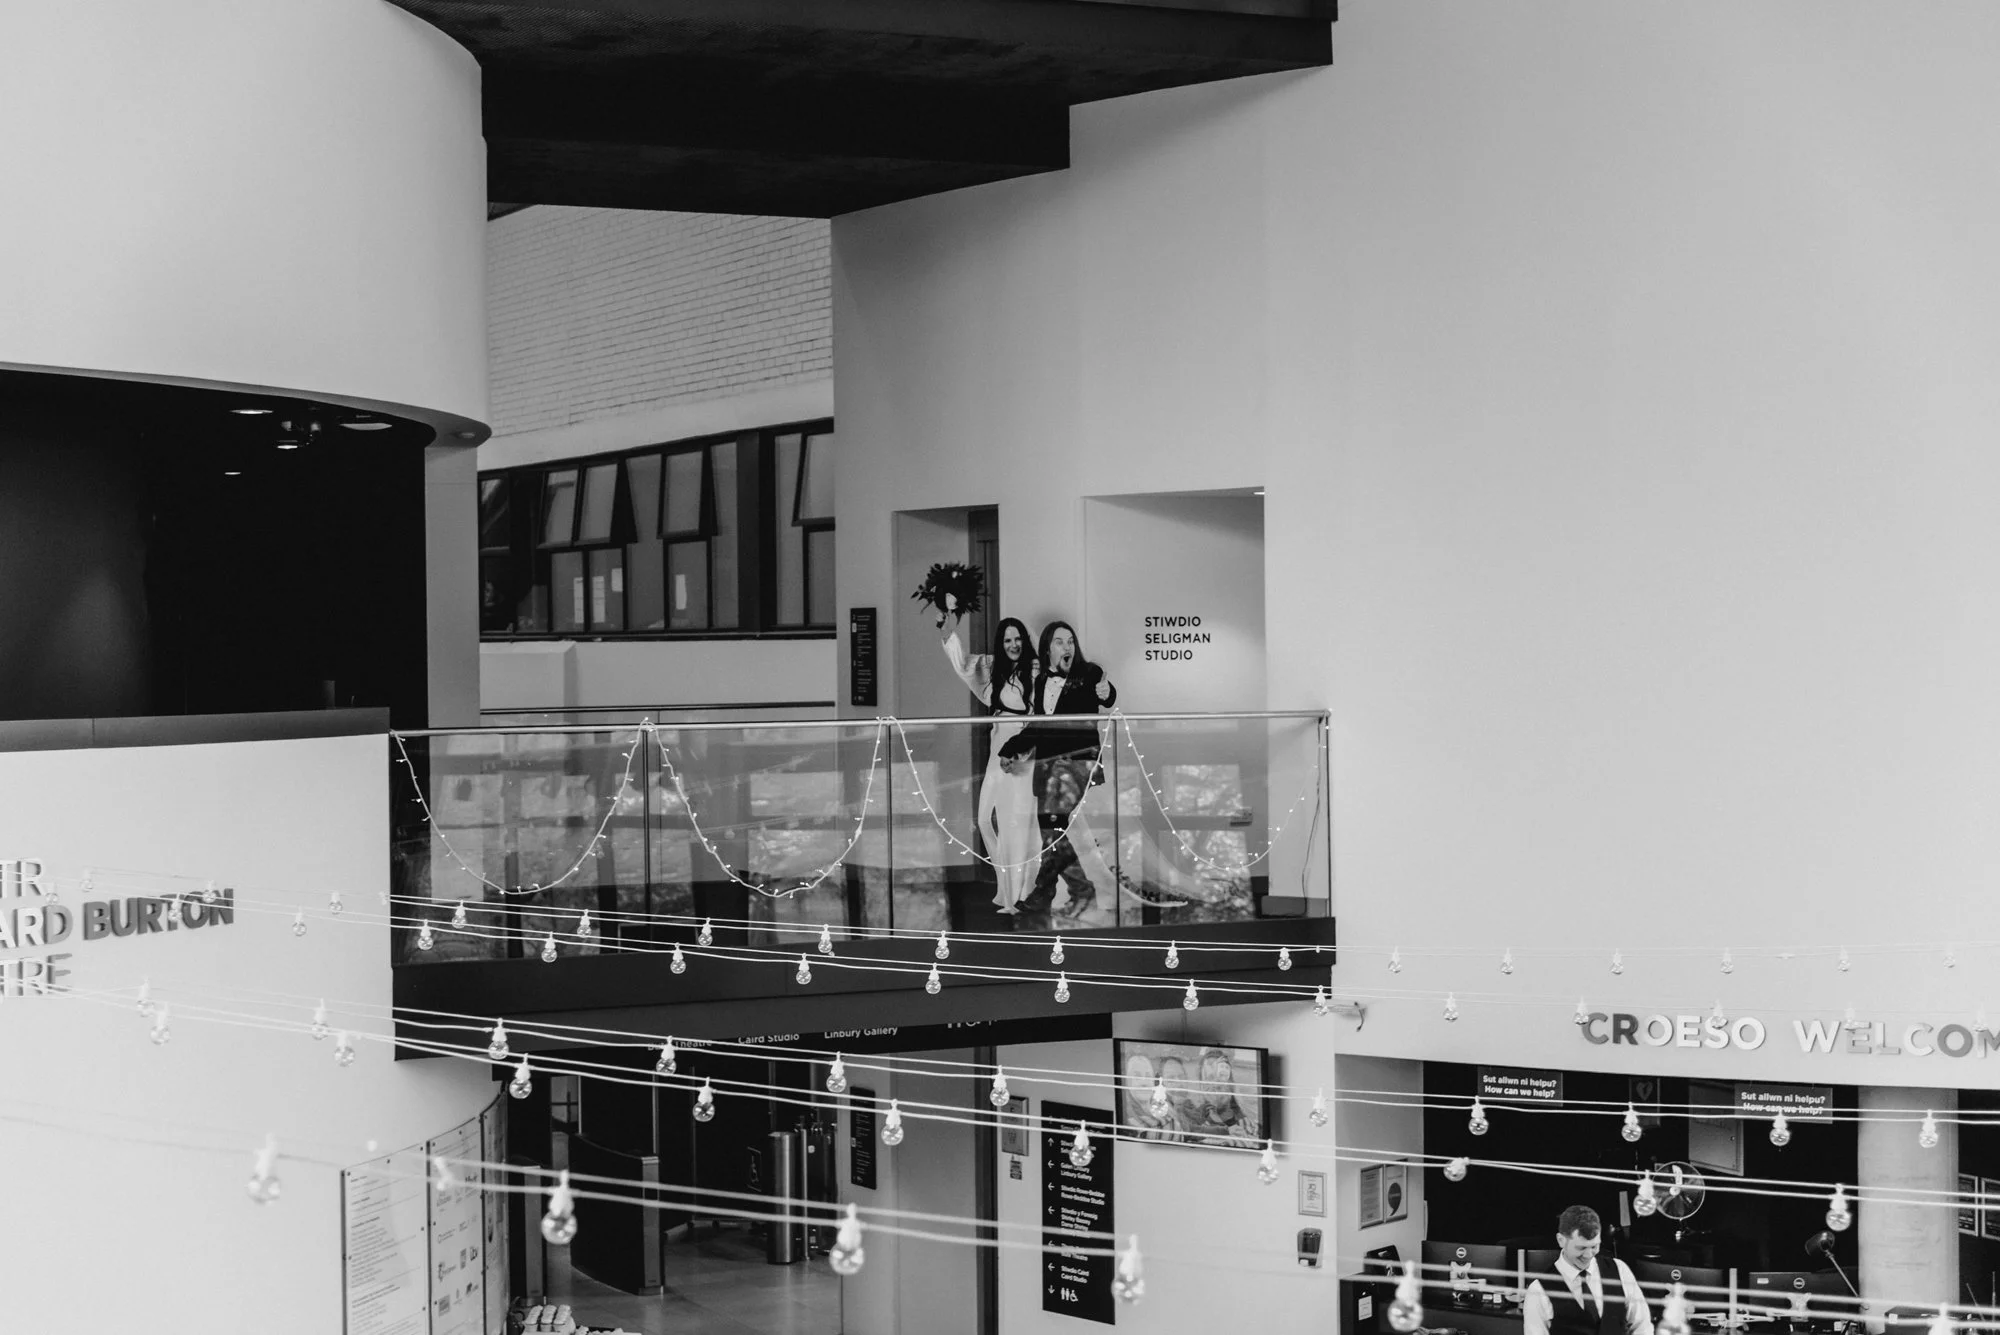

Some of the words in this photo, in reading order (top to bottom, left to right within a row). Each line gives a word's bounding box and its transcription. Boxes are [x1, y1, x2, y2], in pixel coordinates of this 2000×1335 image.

[1145, 616, 1201, 627] STIWDIO
[1145, 633, 1211, 644] SELIGMAN
[1145, 650, 1193, 660] STUDIO
[83, 888, 234, 941] BURTON
[824, 1030, 861, 1039] Linbury
[863, 1027, 898, 1036] Gallery
[1581, 1012, 1766, 1050] CROESO
[767, 1033, 800, 1042] Studio
[1483, 1075, 1496, 1083] Sut
[1498, 1076, 1519, 1085] allwn
[1520, 1078, 1528, 1086] ni
[1529, 1078, 1557, 1088] helpu?
[1484, 1085, 1503, 1094] How
[1533, 1089, 1555, 1098] help?
[1741, 1092, 1756, 1100] Sut
[1758, 1093, 1782, 1102] allwn
[1784, 1094, 1793, 1102] ni
[1795, 1095, 1826, 1105] helpu?
[1743, 1102, 1763, 1111] How
